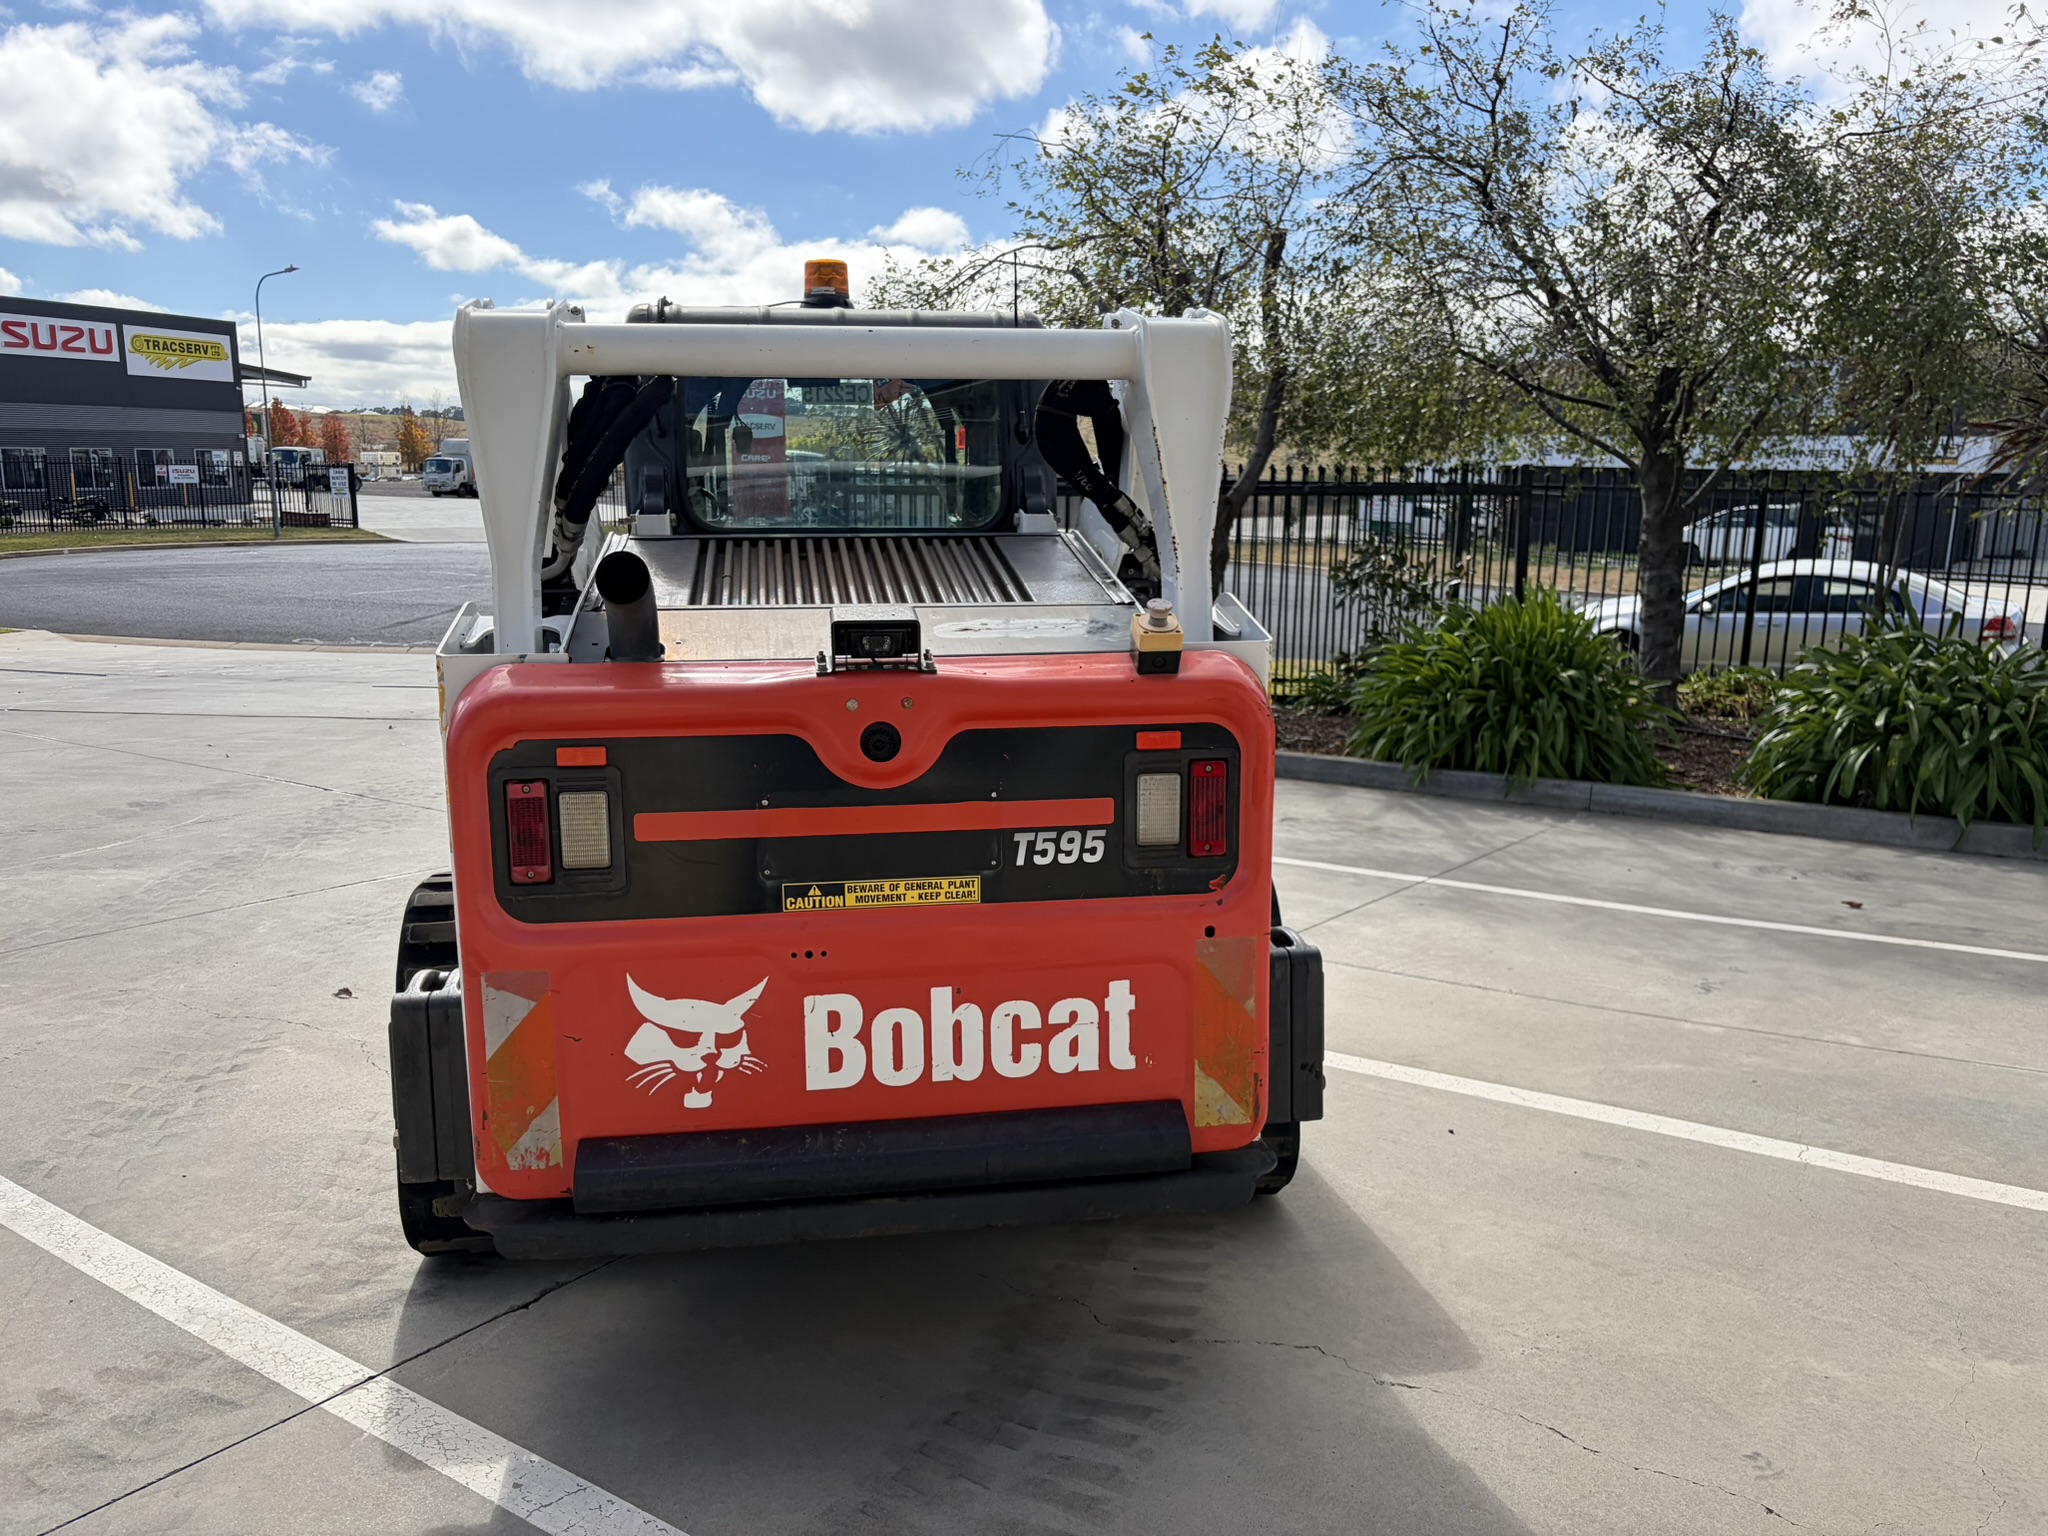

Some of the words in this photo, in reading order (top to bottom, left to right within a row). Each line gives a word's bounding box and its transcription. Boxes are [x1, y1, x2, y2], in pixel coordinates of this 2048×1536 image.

[143, 339, 209, 355] TRACSERV
[1013, 829, 1107, 866] T595
[847, 883, 885, 894] BEWARE
[889, 883, 901, 893] OF
[904, 881, 944, 892] GENERAL
[948, 880, 976, 890] PLANT
[785, 895, 844, 910] CAUTION
[855, 893, 907, 904] MOVEMENT
[918, 891, 942, 901] KEEP
[944, 890, 976, 900] CLEAR!
[803, 979, 1136, 1091] Bobcat
